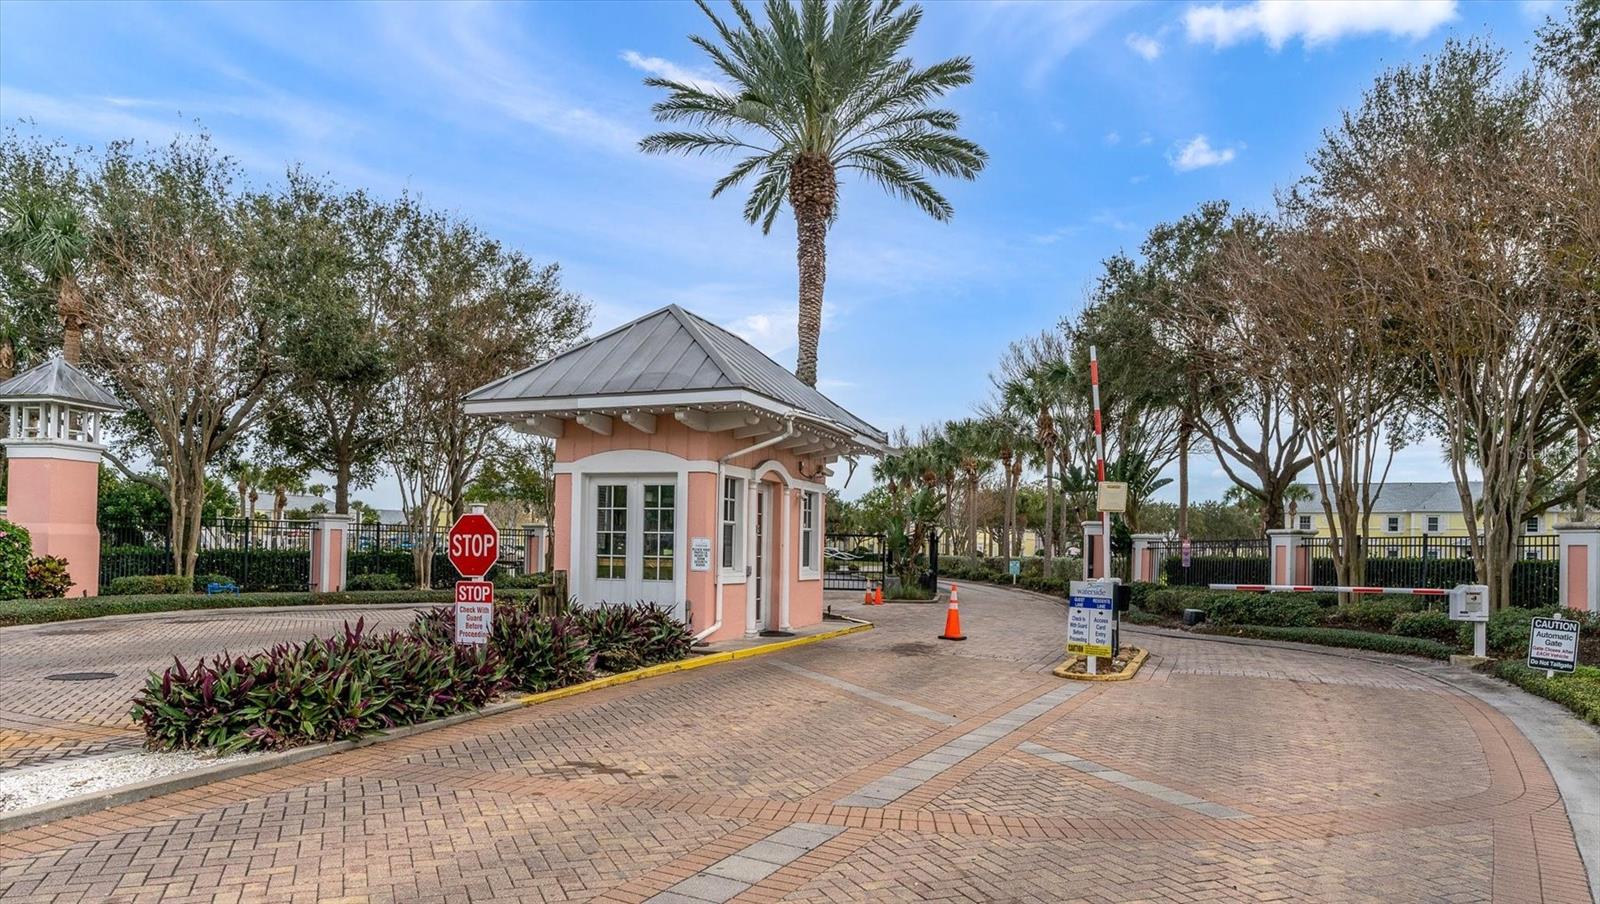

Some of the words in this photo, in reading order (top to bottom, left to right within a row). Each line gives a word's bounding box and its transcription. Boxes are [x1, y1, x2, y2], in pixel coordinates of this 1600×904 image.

[452, 534, 494, 557] STOP
[459, 586, 490, 601] STOP
[1077, 588, 1106, 596] waterside
[460, 606, 476, 614] Check
[477, 606, 489, 614] With
[465, 622, 482, 630] Before
[1535, 620, 1577, 631] CAUTION
[1536, 631, 1573, 641] Automatic
[1545, 639, 1563, 647] Gate
[1068, 644, 1083, 653] CAUTION
[1550, 661, 1573, 669] Tailgate
